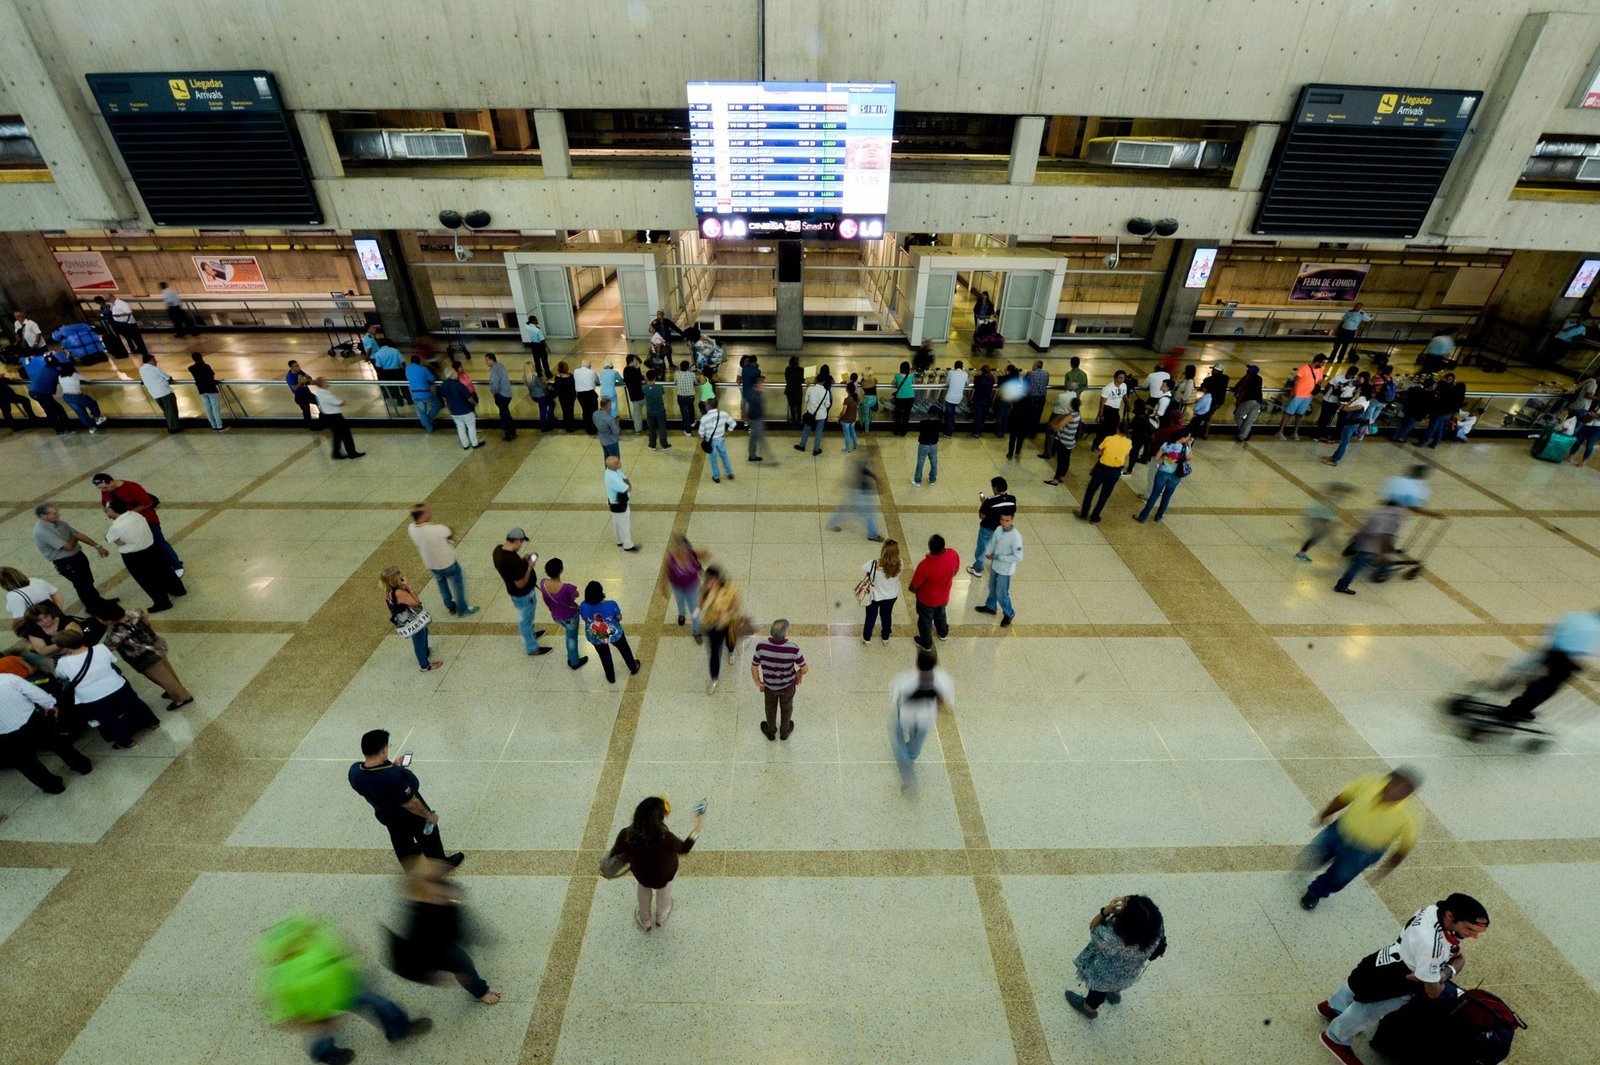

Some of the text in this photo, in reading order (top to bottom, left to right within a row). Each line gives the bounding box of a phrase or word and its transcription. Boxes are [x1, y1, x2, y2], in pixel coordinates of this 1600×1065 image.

[189, 79, 223, 91] Llegadas
[195, 90, 223, 99] Arrivals
[1401, 95, 1432, 106] Llegadas
[1397, 105, 1424, 116] Arrivals
[723, 220, 746, 236] LG
[748, 221, 784, 230] CINEMA
[802, 222, 822, 230] Smart
[860, 221, 882, 236] LG
[1302, 278, 1357, 287] FERIA DE COMIDA
[408, 619, 423, 633] PARIS
